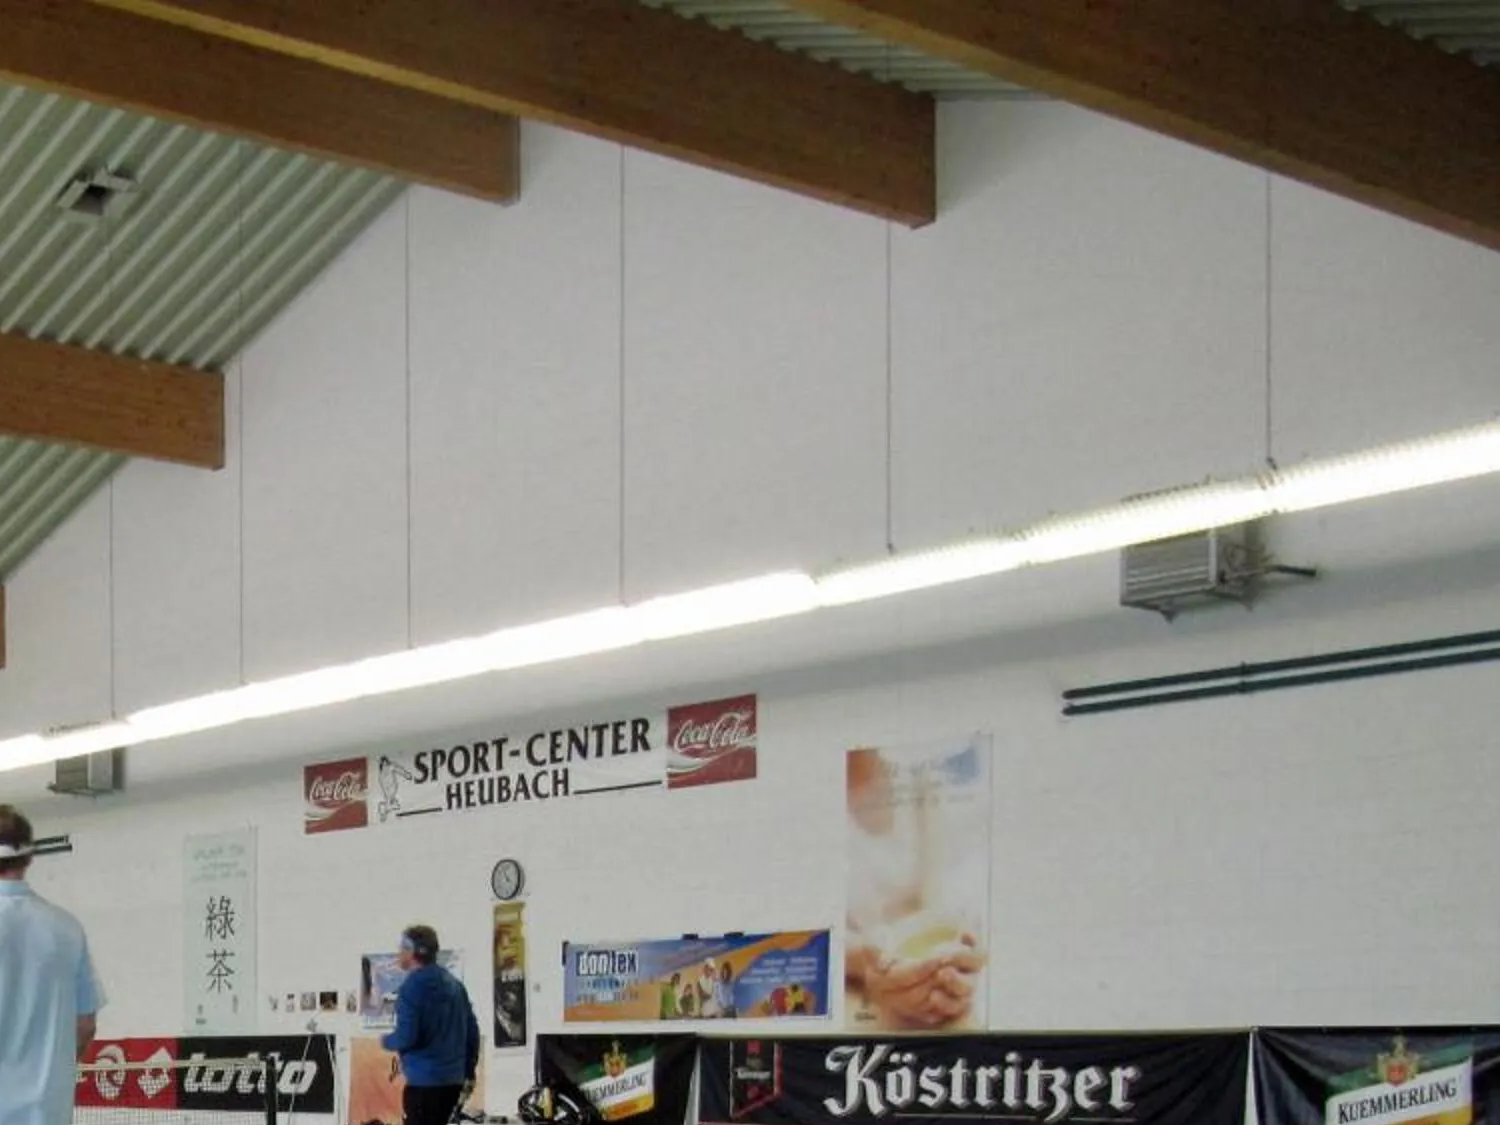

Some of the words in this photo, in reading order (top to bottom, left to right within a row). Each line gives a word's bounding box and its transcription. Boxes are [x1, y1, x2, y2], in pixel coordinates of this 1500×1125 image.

[413, 717, 652, 785] SPORT-CENTER
[446, 767, 570, 810] HEUBACH
[823, 1043, 1142, 1124] Köstritzer
[1338, 1078, 1457, 1125] KUEMMERLING
